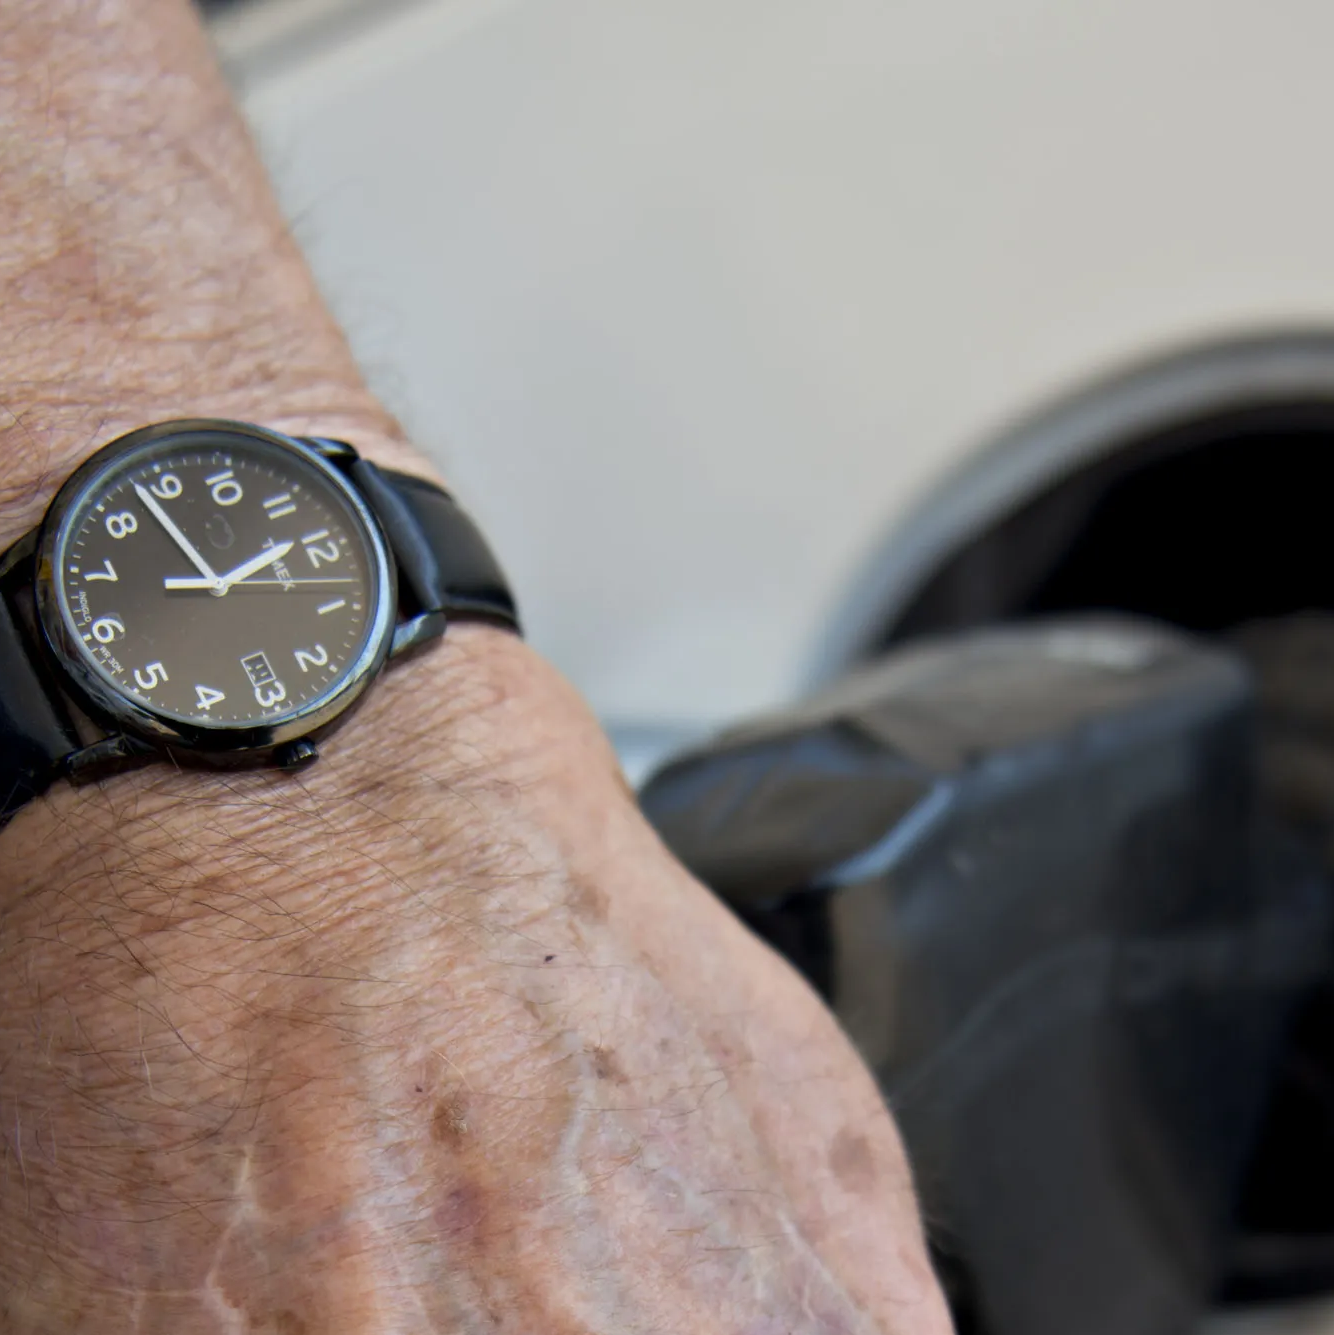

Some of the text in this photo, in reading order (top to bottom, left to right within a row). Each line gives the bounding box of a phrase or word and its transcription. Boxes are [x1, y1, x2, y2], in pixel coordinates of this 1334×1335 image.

[151, 475, 183, 500] 9
[206, 471, 243, 506] 10
[263, 493, 297, 520] 11
[105, 511, 137, 539] 8
[302, 529, 339, 568] 12
[84, 560, 119, 582] 7
[262, 538, 296, 592] TMEX
[79, 591, 92, 622] INDIGLO
[318, 600, 346, 615] 1
[92, 618, 125, 644] 6
[99, 645, 111, 658] WR
[294, 645, 328, 672] 2
[135, 662, 169, 690] 5
[195, 684, 225, 710] 4
[254, 680, 286, 707] 3
